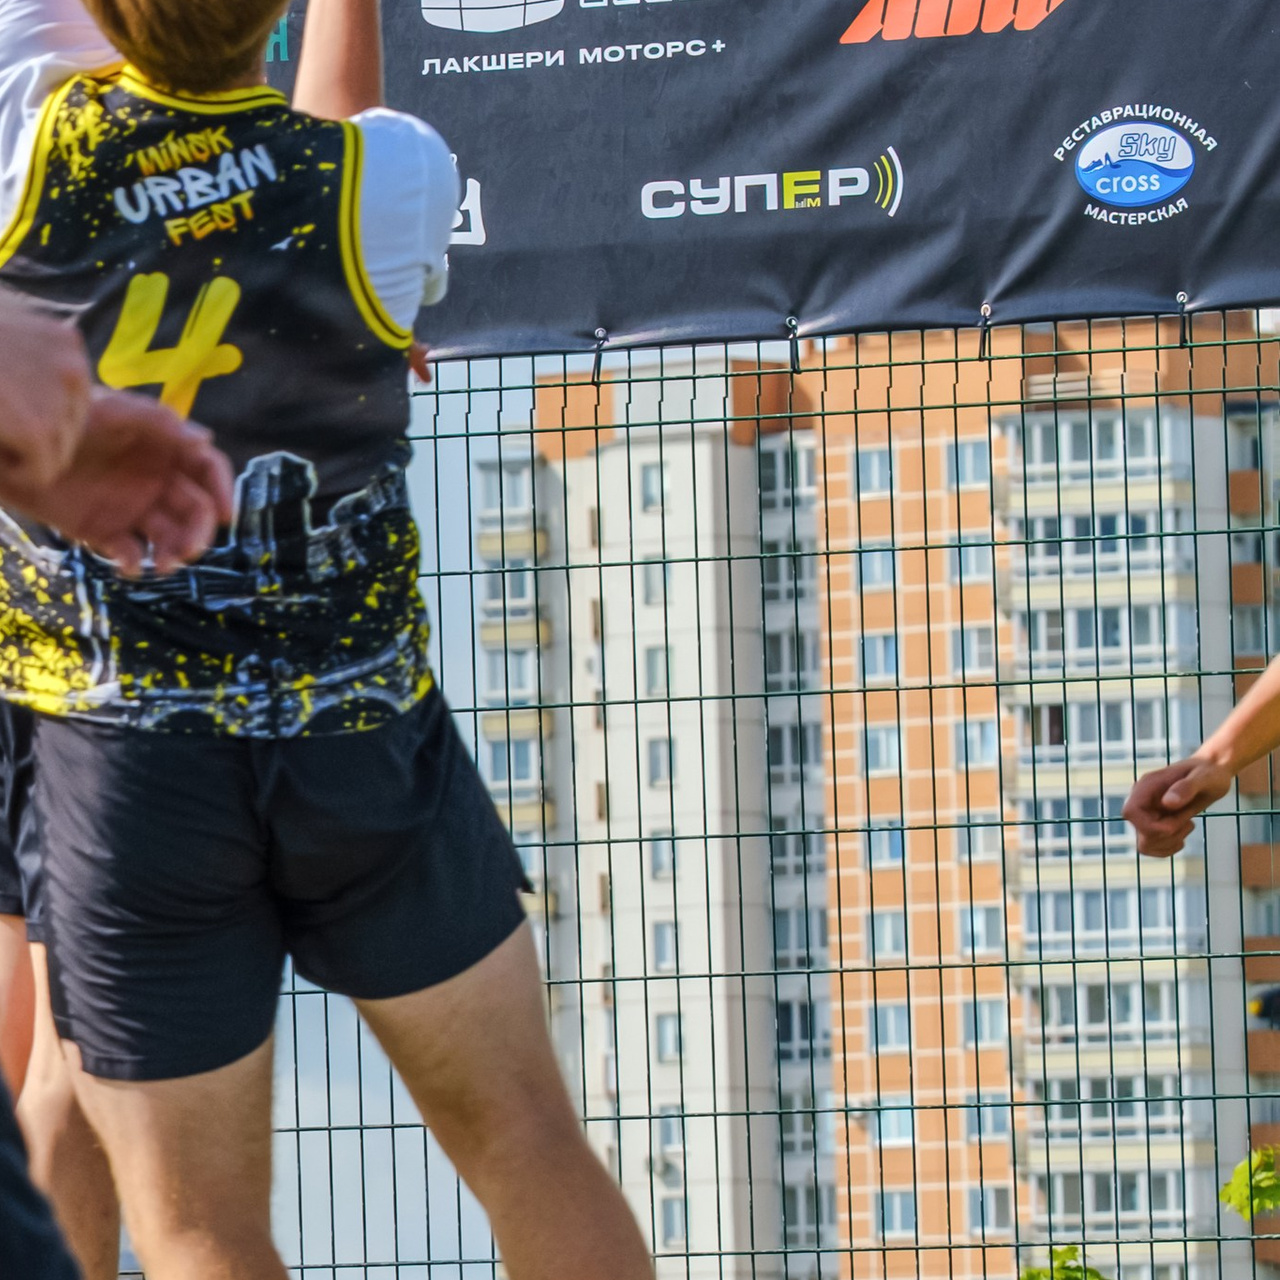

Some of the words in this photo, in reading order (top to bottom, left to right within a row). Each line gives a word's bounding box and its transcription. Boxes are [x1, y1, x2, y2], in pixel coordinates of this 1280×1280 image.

[421, 50, 565, 75] ЛАКШЕРИ
[1053, 104, 1218, 162] РЕСТАВРАЦИОННАЯ
[1118, 132, 1176, 162] Sky
[113, 143, 278, 224] URBAN
[1095, 174, 1160, 194] cross
[164, 189, 255, 247] FEST
[1084, 197, 1189, 225] МАСТЕРСКАЯ
[97, 272, 243, 421] 4
